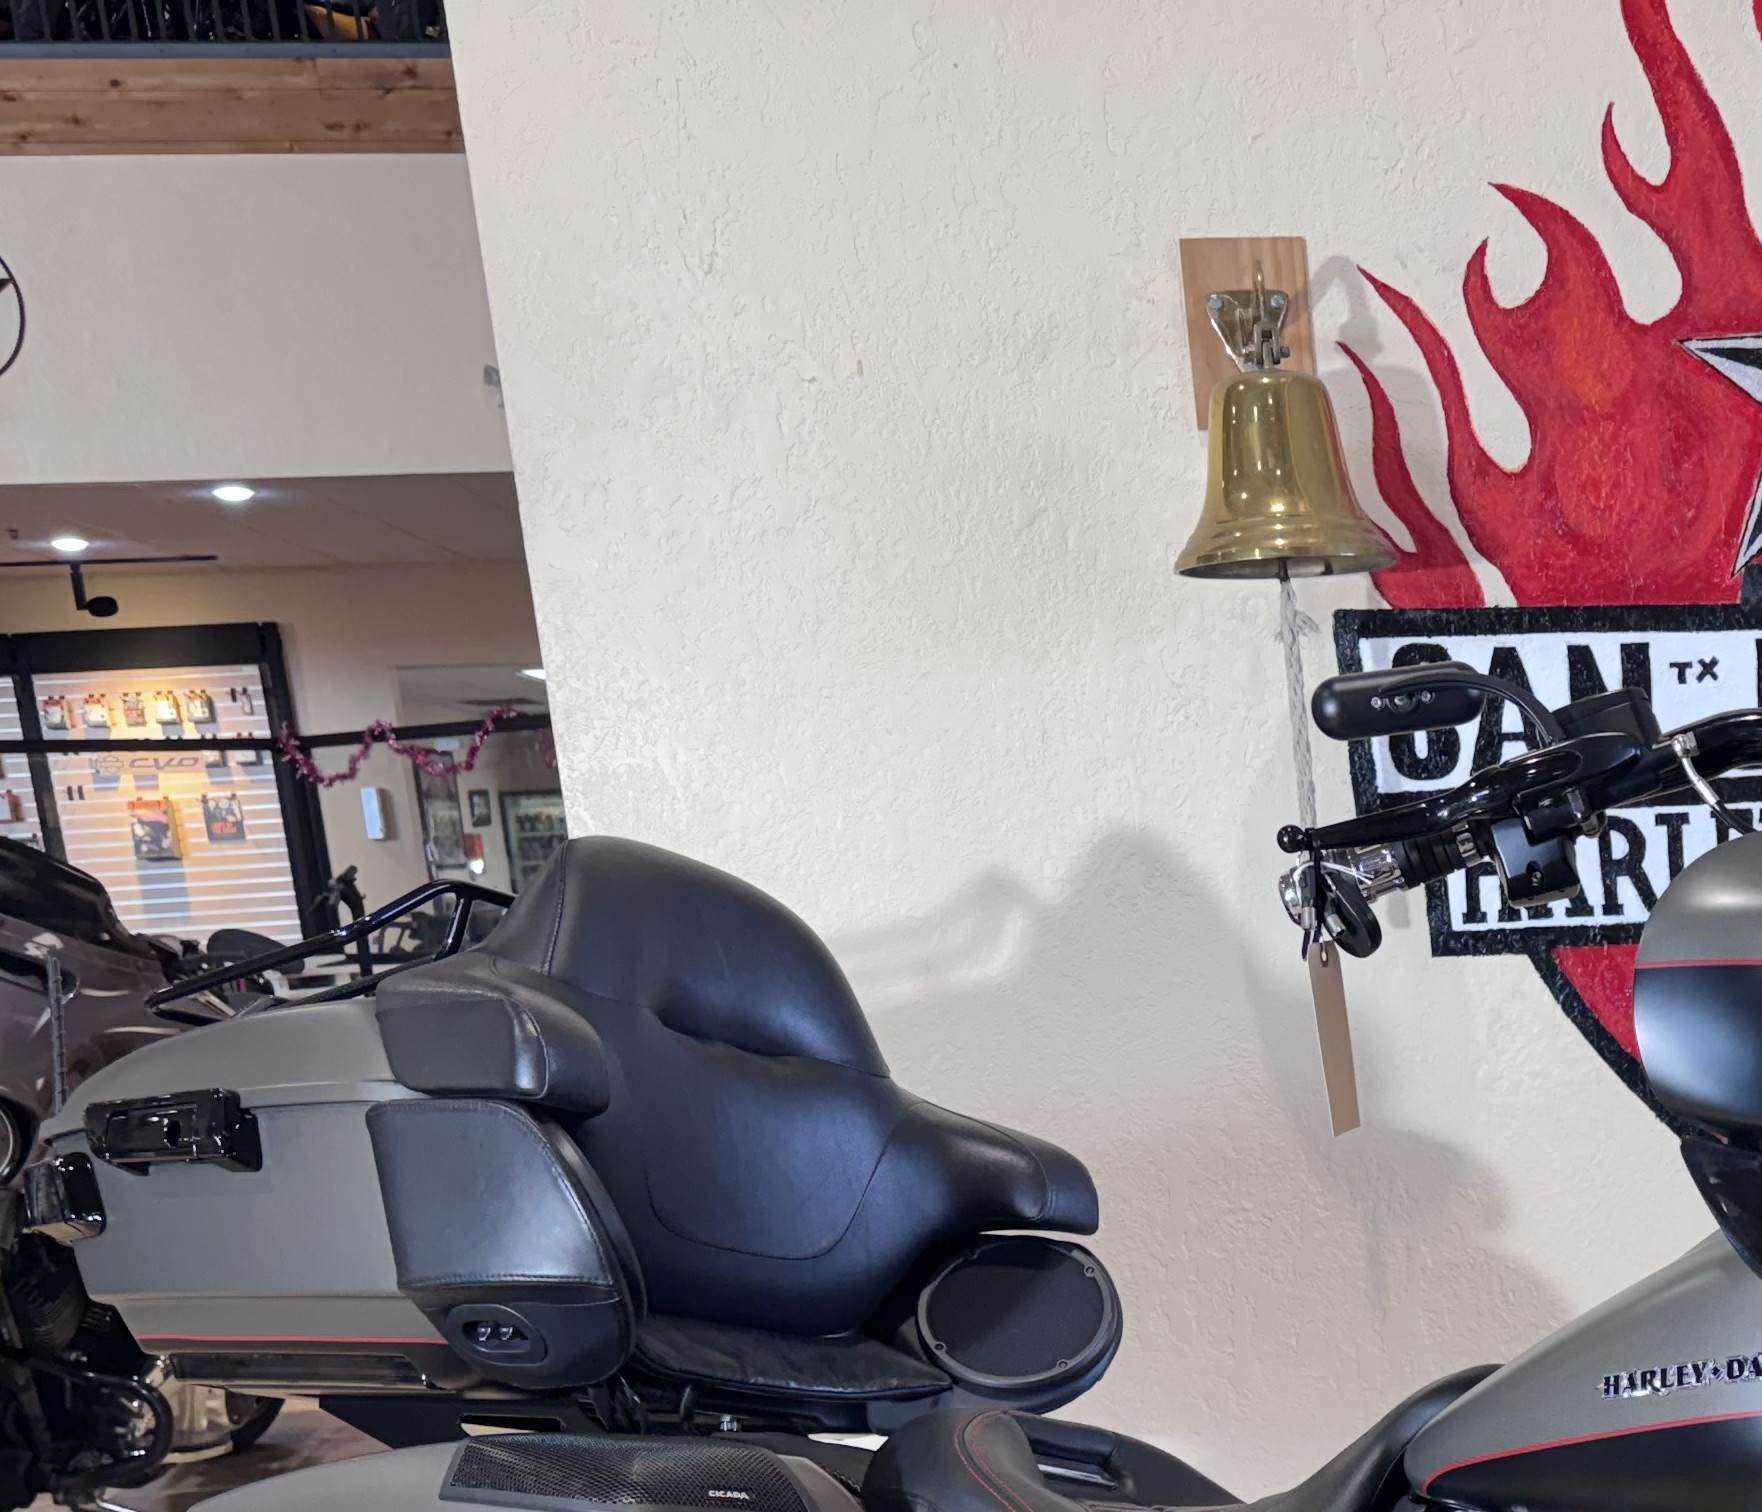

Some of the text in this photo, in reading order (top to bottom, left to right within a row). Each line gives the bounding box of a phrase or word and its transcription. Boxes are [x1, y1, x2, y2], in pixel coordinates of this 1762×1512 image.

[1669, 656, 1720, 685] TX
[128, 756, 200, 770] CVO
[708, 1489, 750, 1500] CICADA
